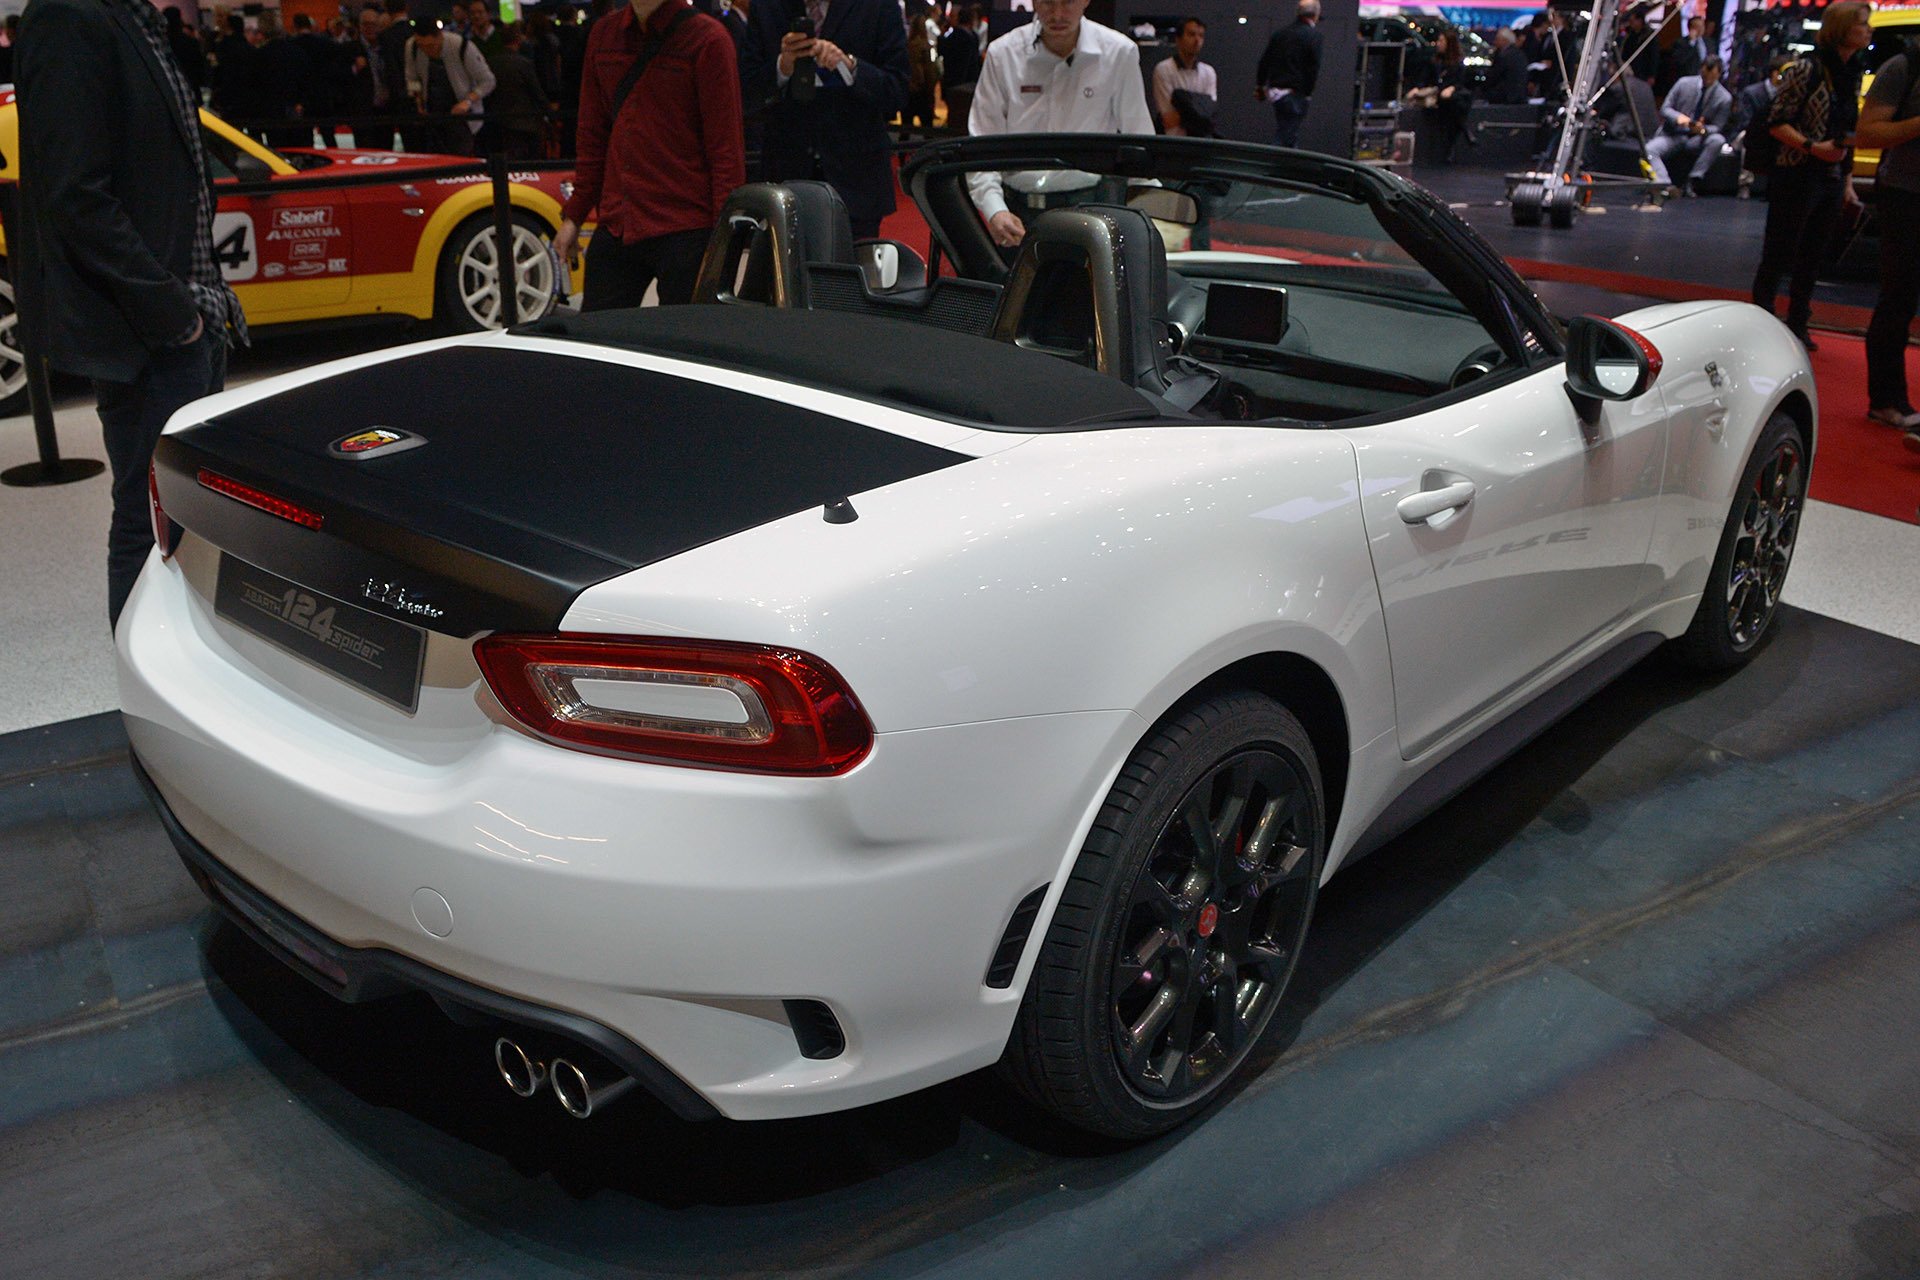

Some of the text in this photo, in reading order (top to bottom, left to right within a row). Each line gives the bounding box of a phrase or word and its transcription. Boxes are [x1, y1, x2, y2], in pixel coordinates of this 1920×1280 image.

[243, 588, 282, 615] ABARTH
[279, 588, 336, 643] 124
[331, 630, 380, 660] spider
